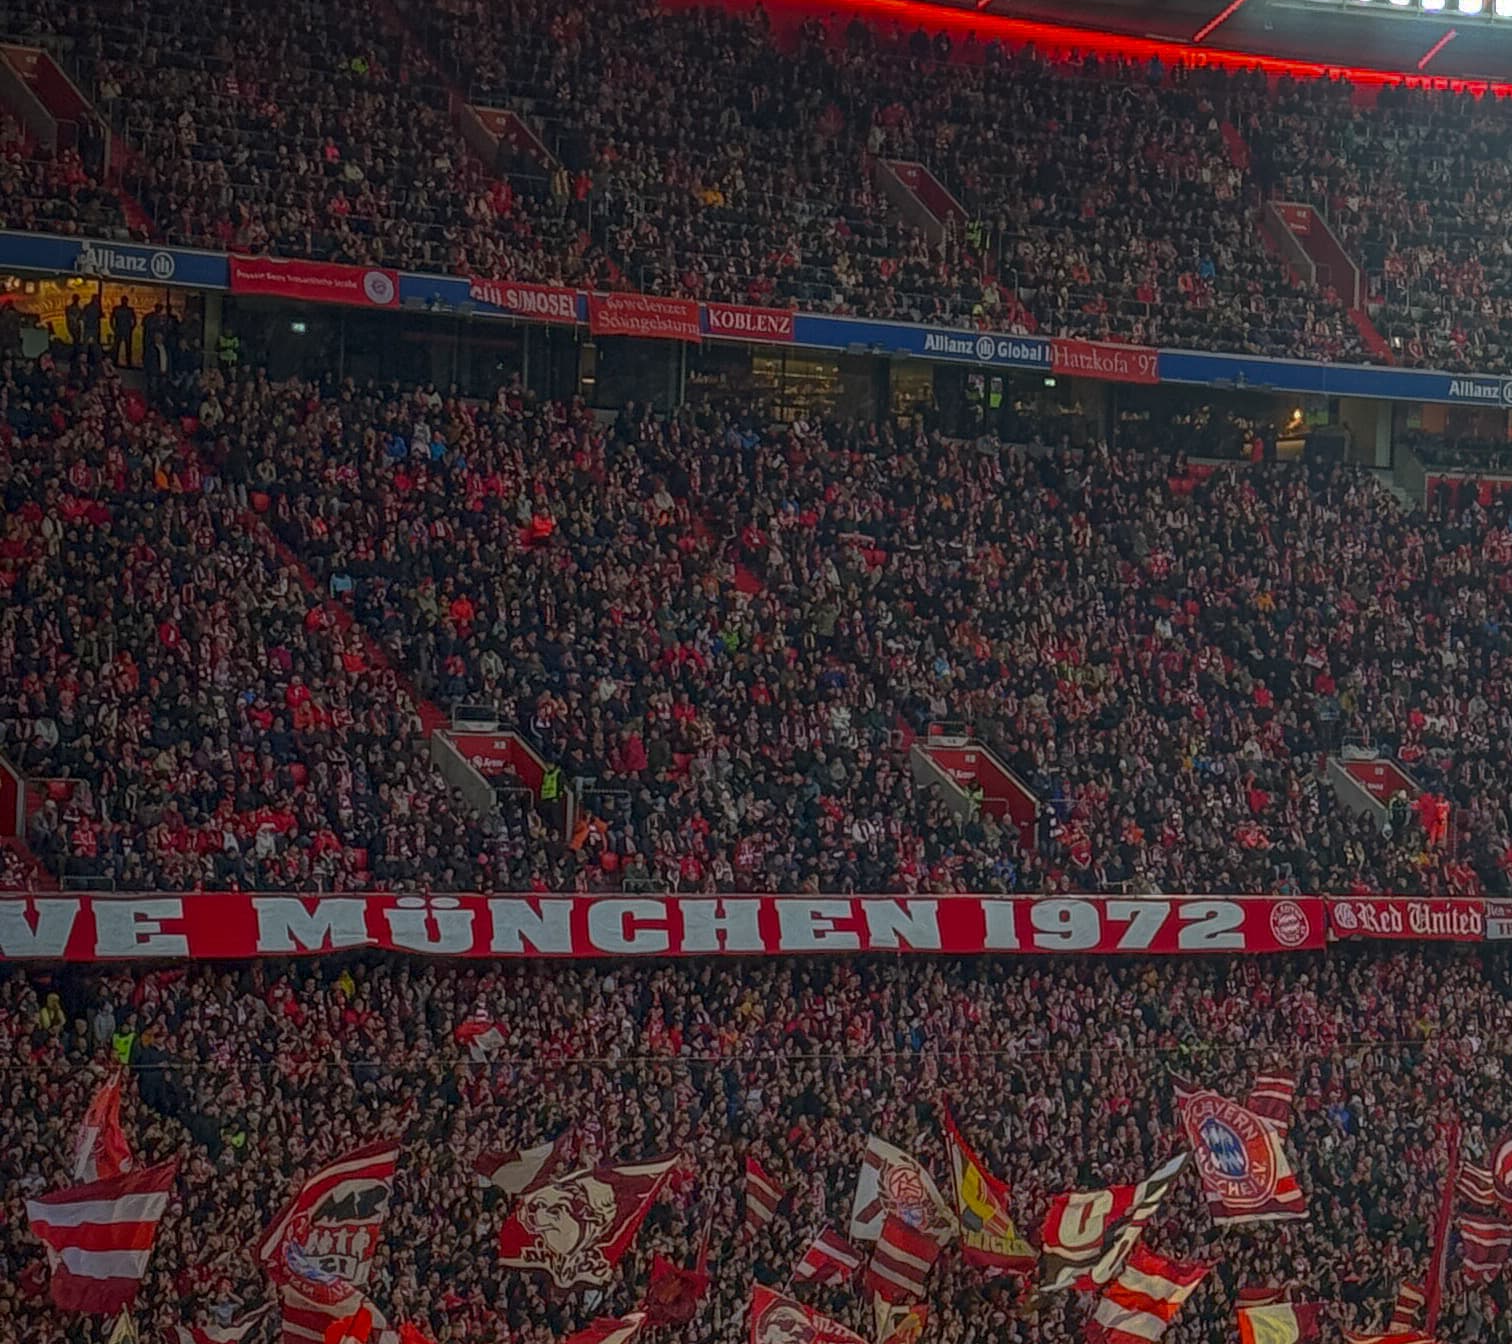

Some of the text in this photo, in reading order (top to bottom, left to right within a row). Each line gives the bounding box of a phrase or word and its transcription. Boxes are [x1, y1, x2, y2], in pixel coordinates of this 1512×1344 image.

[84, 247, 148, 272] Allianz
[708, 307, 792, 335] KOBLENZ
[924, 334, 975, 356] Allianz
[998, 339, 1042, 362] Global
[1448, 380, 1500, 400] Allianz
[251, 896, 944, 954] MÜNCHEN
[979, 900, 1247, 951] 1972
[1356, 898, 1483, 935] Red United
